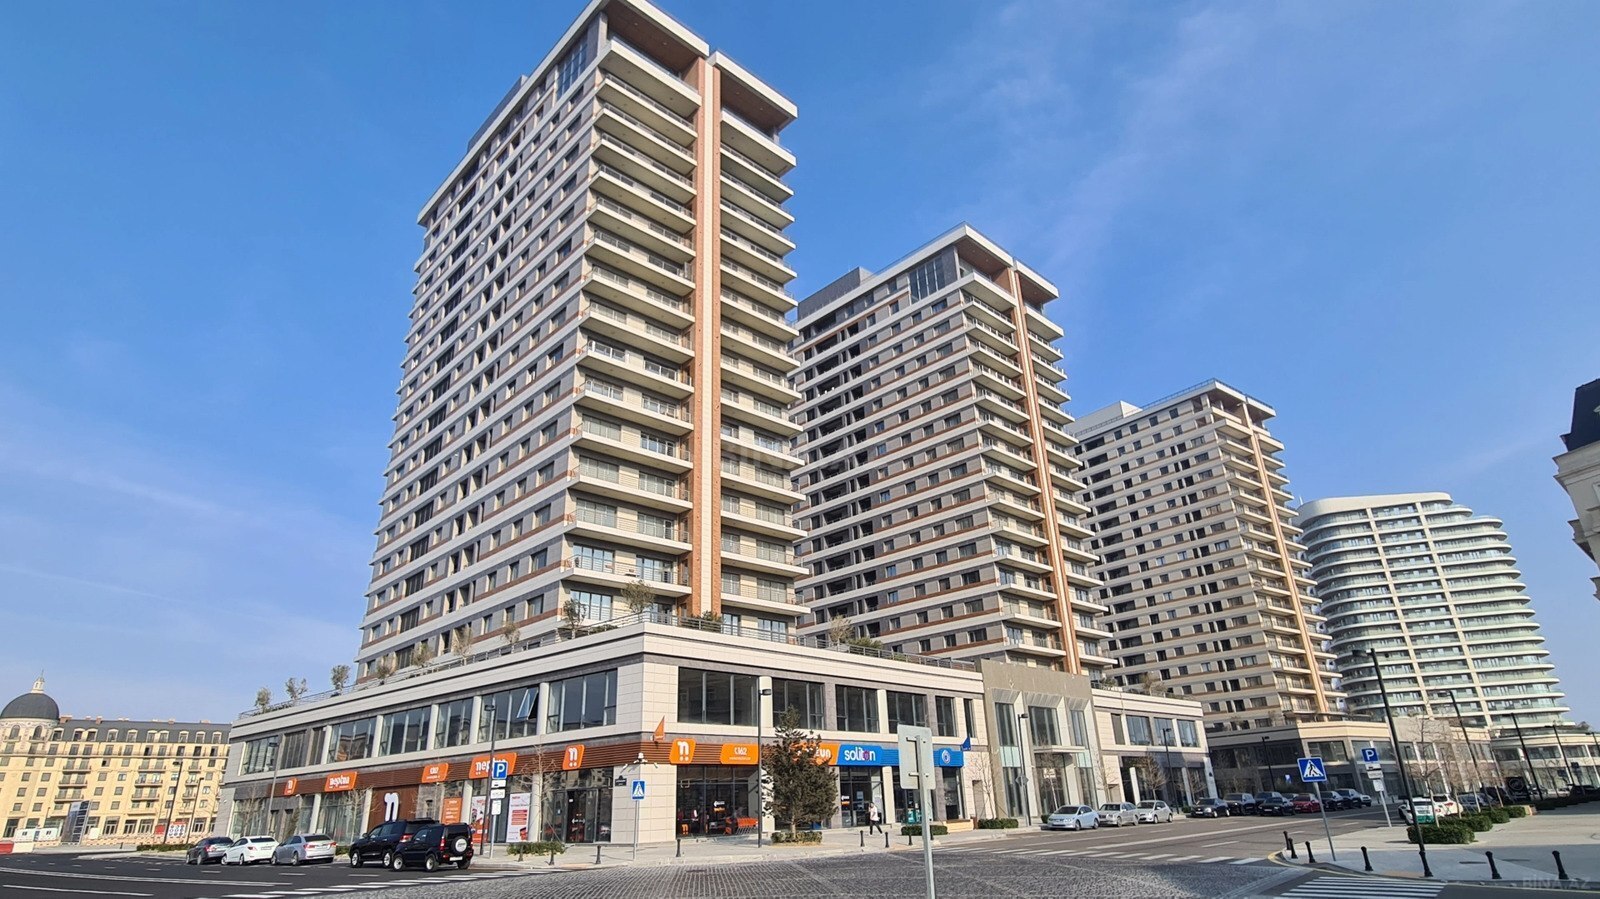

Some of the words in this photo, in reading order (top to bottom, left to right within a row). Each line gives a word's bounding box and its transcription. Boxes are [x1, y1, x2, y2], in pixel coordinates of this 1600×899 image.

[844, 747, 876, 761] soliton
[1366, 750, 1375, 761] P
[497, 763, 506, 777] P
